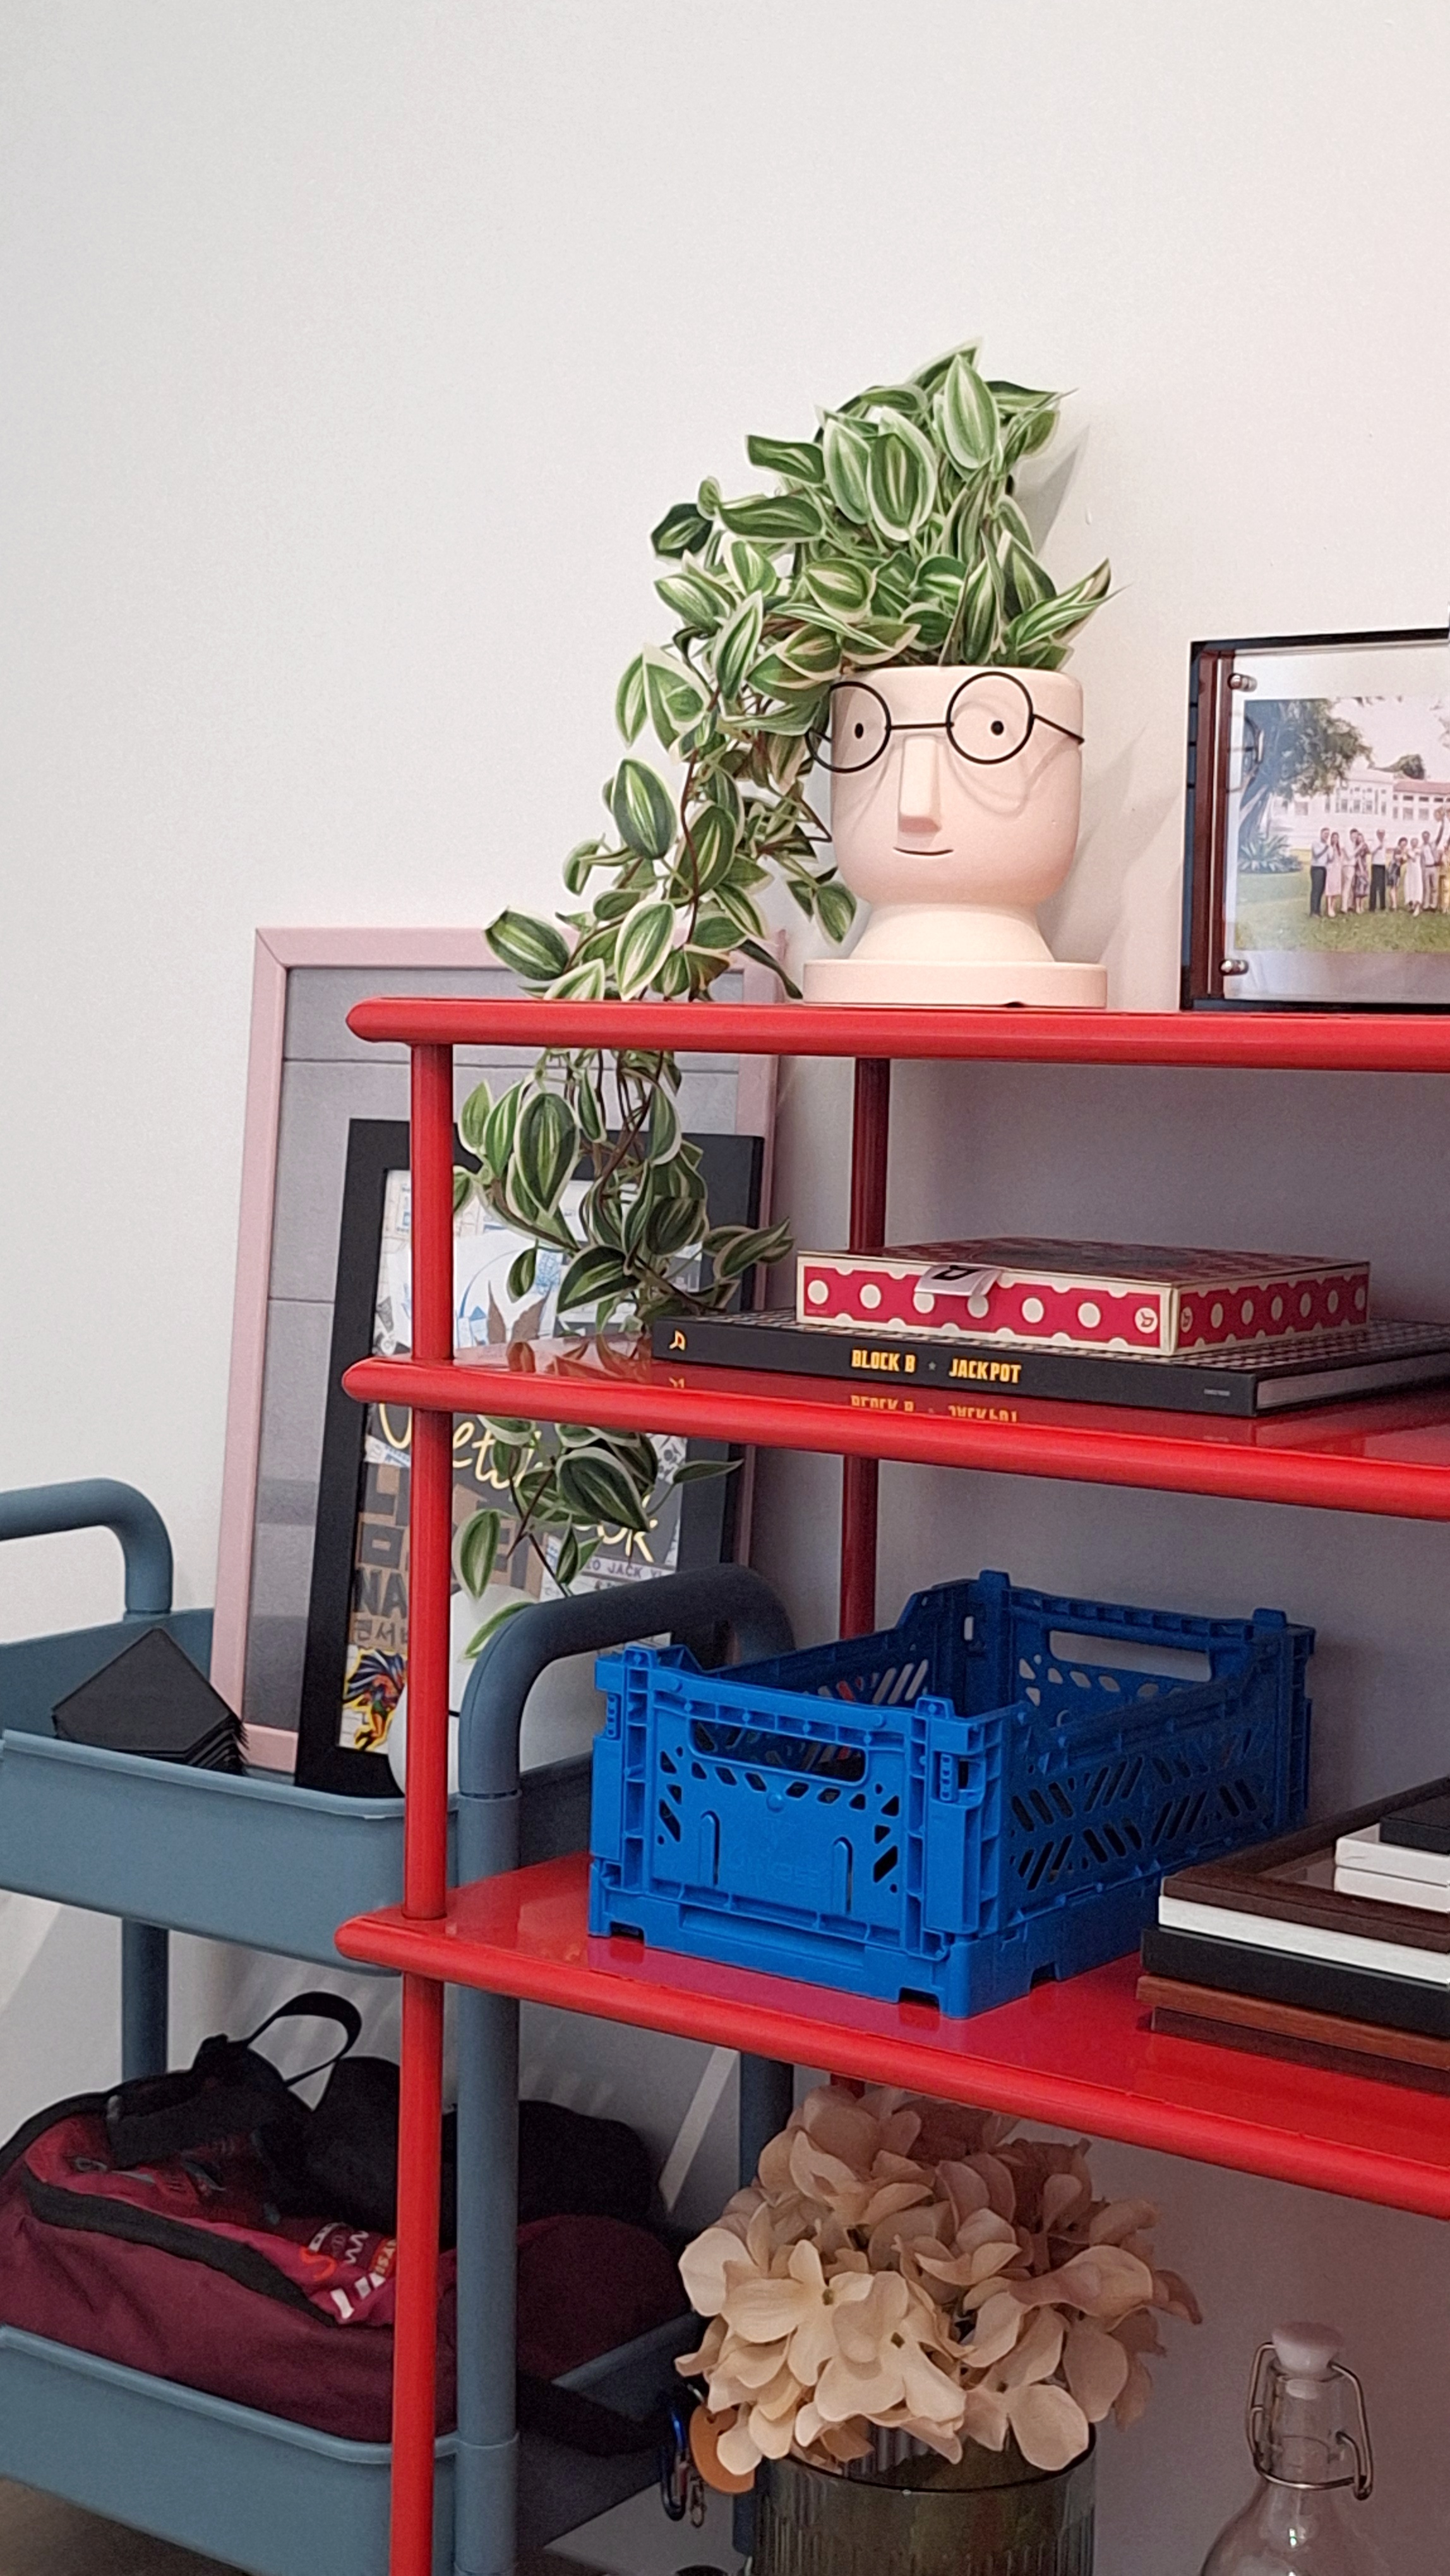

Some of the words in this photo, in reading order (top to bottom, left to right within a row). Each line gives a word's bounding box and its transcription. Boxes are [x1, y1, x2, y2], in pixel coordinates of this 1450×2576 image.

[852, 1350, 900, 1372] BLOCK
[904, 1354, 916, 1373] B
[949, 1358, 1021, 1383] JACKPOT
[608, 1563, 643, 1578] JACK
